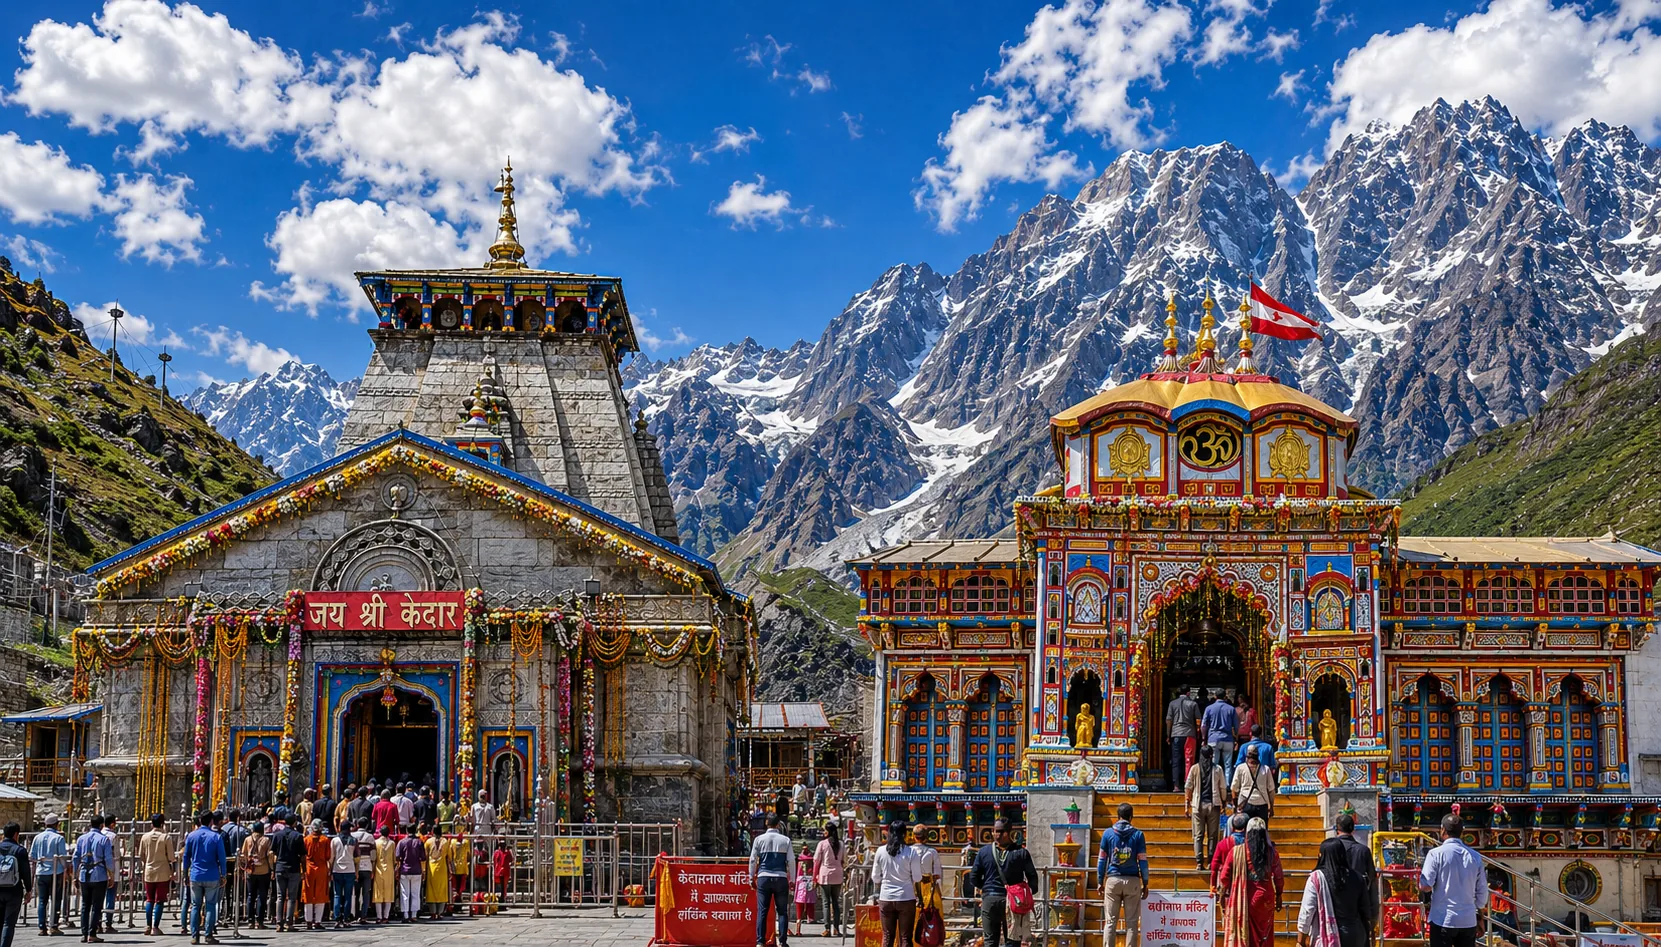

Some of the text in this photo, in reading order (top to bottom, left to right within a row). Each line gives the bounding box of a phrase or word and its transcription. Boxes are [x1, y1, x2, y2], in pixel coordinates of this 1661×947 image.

[309, 593, 458, 628] जय श्री केदार
